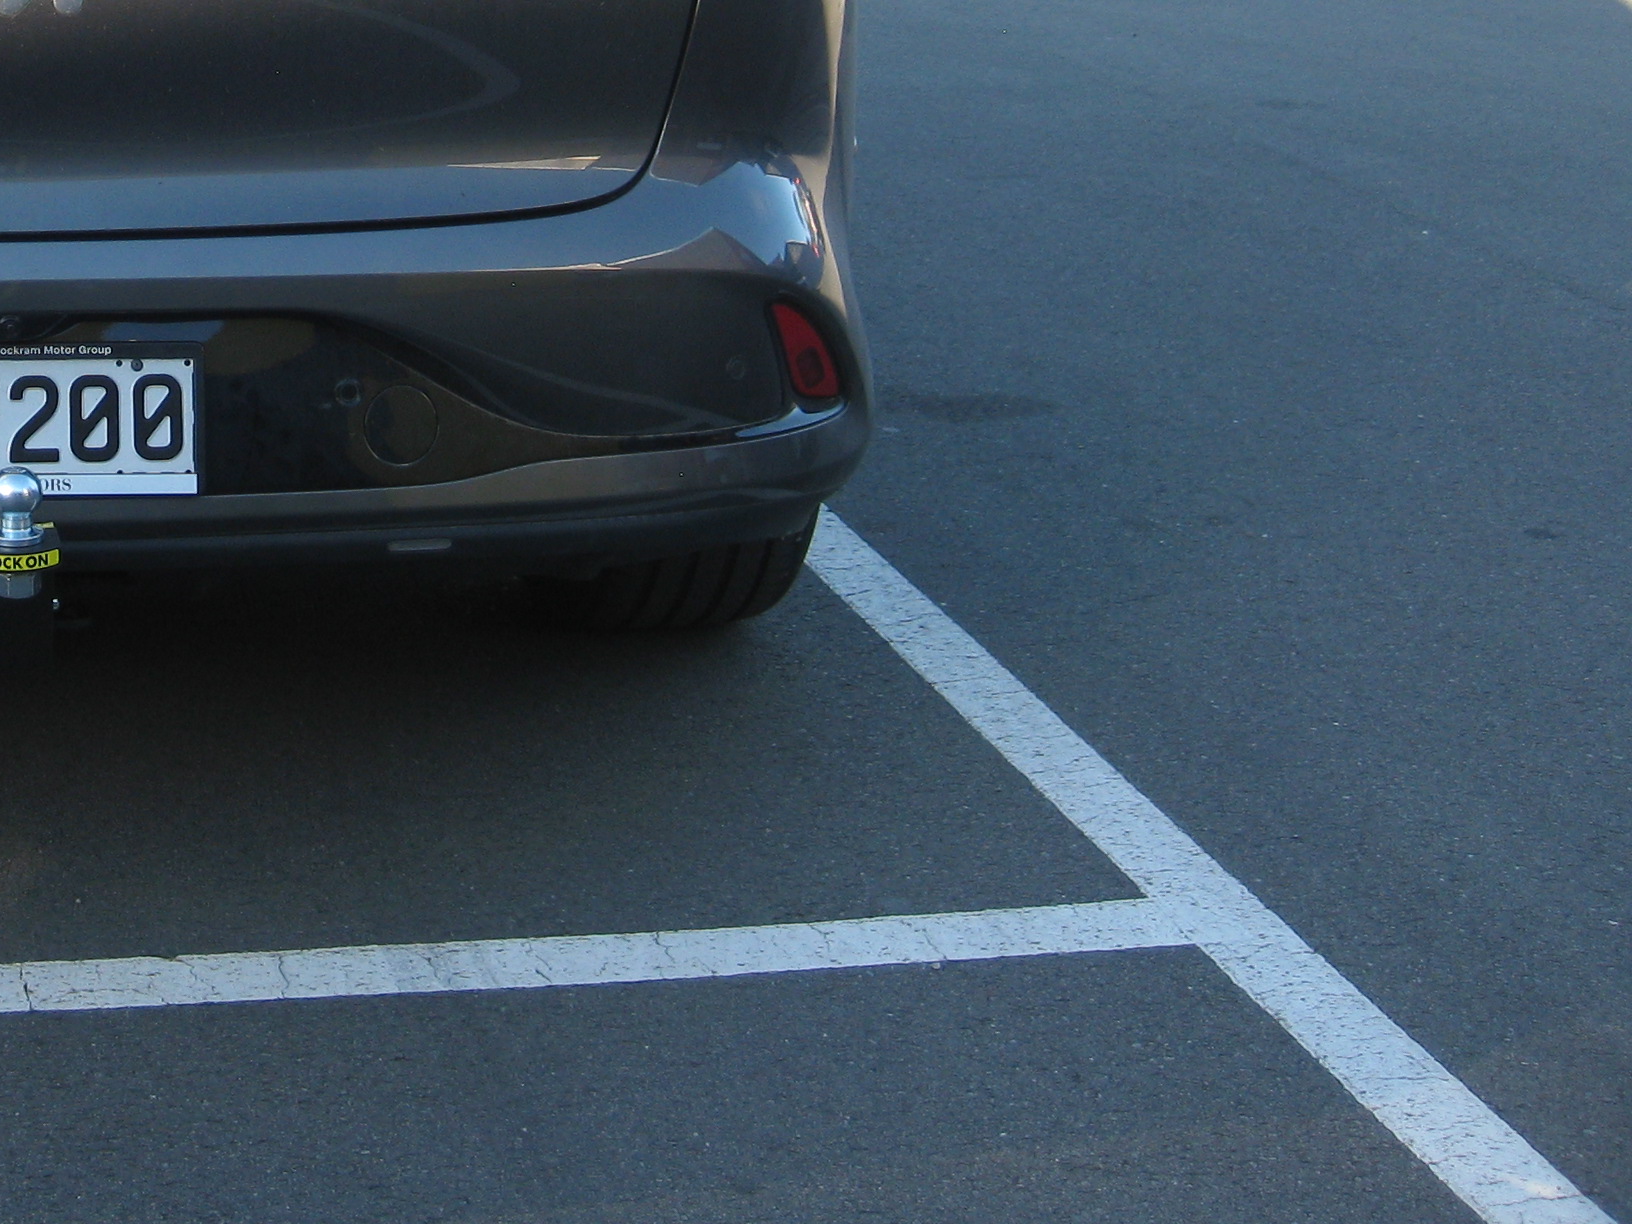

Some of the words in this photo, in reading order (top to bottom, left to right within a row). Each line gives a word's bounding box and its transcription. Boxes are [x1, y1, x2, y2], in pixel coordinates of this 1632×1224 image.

[43, 346, 75, 356] Motor
[78, 345, 112, 356] Group
[25, 553, 49, 568] ON
